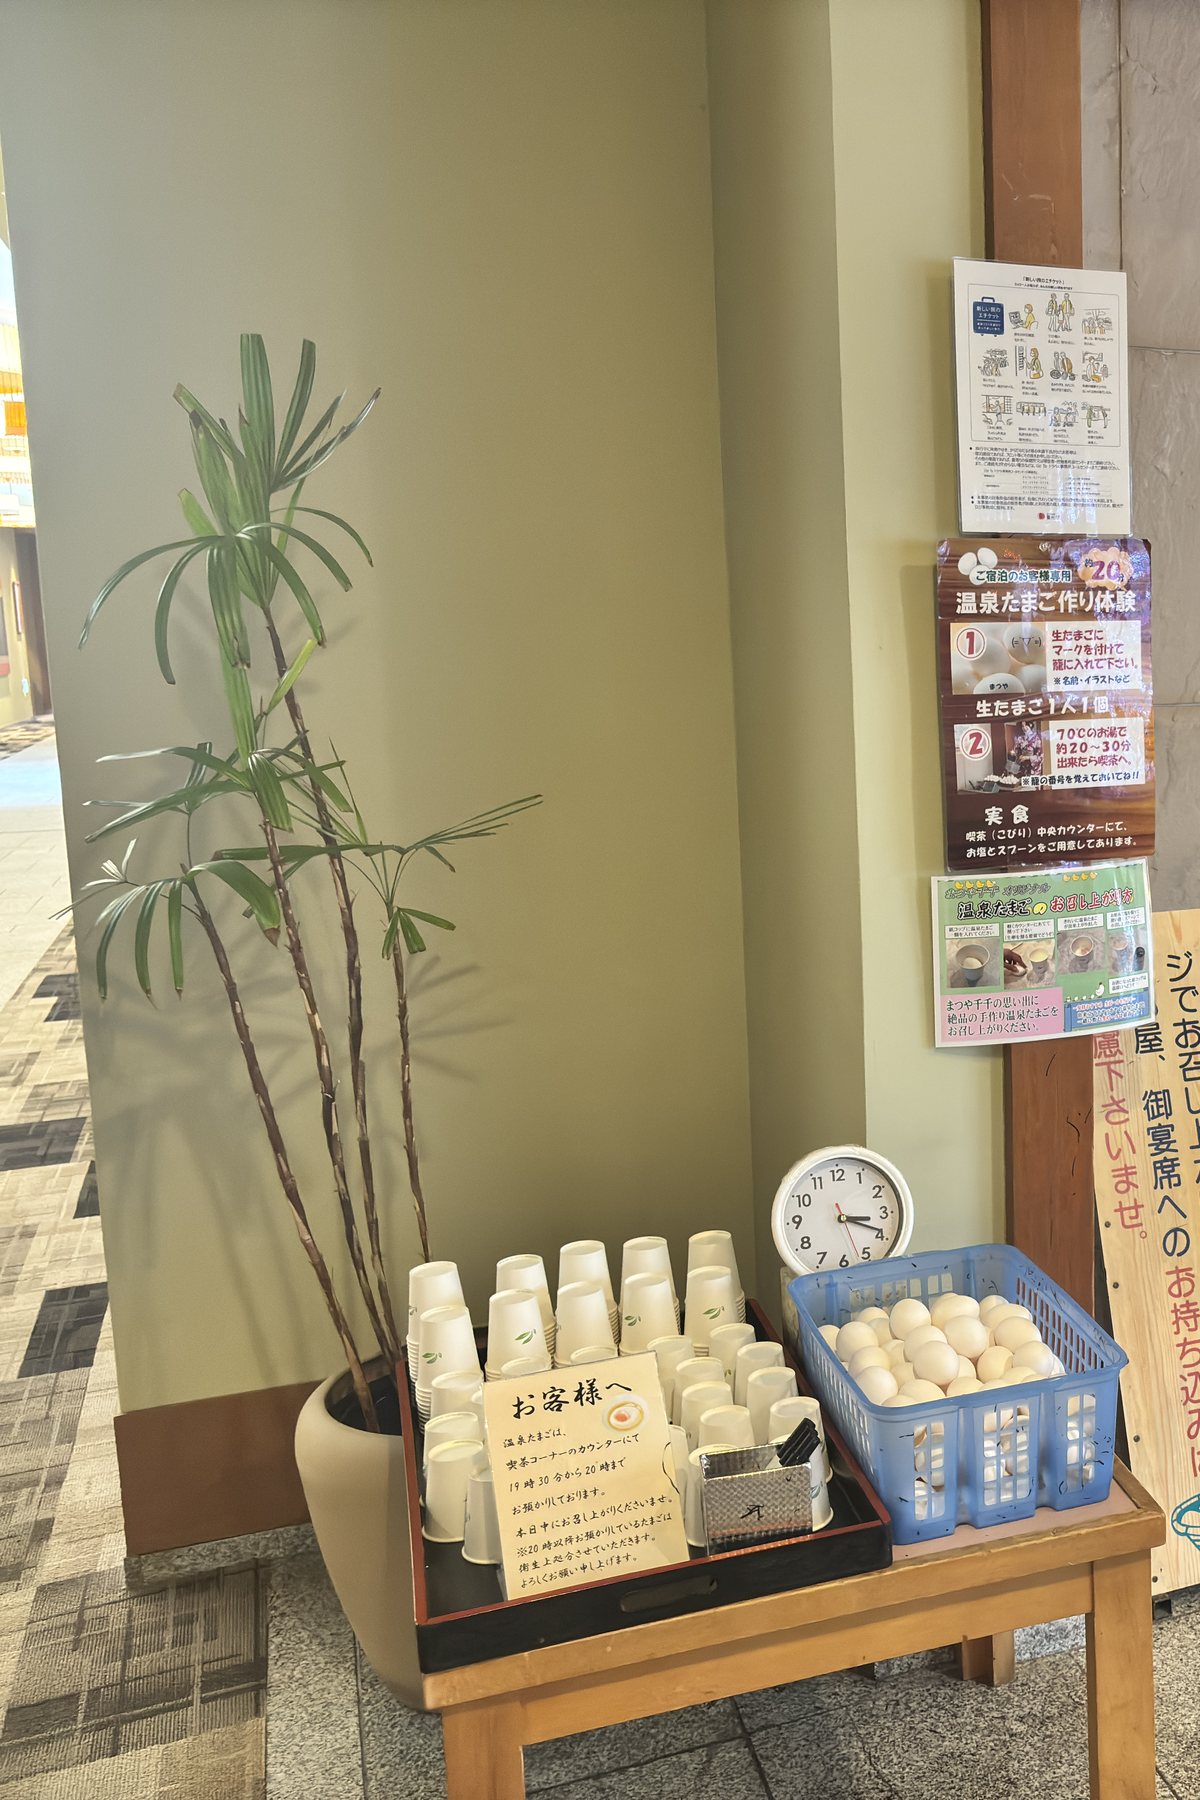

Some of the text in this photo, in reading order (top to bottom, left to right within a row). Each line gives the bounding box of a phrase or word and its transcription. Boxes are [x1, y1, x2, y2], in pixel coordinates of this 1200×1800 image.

[975, 569, 1072, 584] ご宿泊のお客様専用
[956, 589, 1137, 615] 温泉たまご作り体験
[1052, 628, 1103, 642] 生たまごに
[1052, 643, 1124, 656] マークを付けて
[1052, 658, 1138, 672] 籠に入れて下さい。
[989, 683, 1009, 691] まつや
[1056, 755, 1132, 769] 出来たら喫茶へ。
[984, 805, 1030, 826] 実食
[966, 836, 1137, 859] お塩とスプーンをご用意してあります。
[946, 995, 1039, 1011] まつや千千の思い出に
[947, 1007, 1059, 1025] 絶品の手作り温泉たまごを
[948, 1022, 1040, 1037] お召し上がりください。
[811, 1176, 823, 1190] 11
[830, 1169, 845, 1182] 12
[856, 1172, 862, 1184] 1
[872, 1185, 882, 1199] 2
[796, 1193, 811, 1208] 10
[879, 1206, 888, 1220] 3
[791, 1214, 803, 1230] 9
[875, 1228, 885, 1241] 4
[800, 1236, 811, 1250] 8
[816, 1251, 827, 1265] 7
[839, 1254, 849, 1268] 6
[861, 1247, 871, 1260] 5
[512, 1378, 633, 1420] お客様へ
[502, 1427, 567, 1449] 温泉たまごは、
[506, 1433, 640, 1471] 喫茶コーナーのカウンターにて
[512, 1486, 606, 1516] お預かりしております。
[515, 1494, 674, 1539] 本日中にお召し上がりくださいませ。
[518, 1531, 657, 1573] 衛生上処分させていただきます。
[520, 1551, 639, 1589] よろしくお願い申し上げます。
